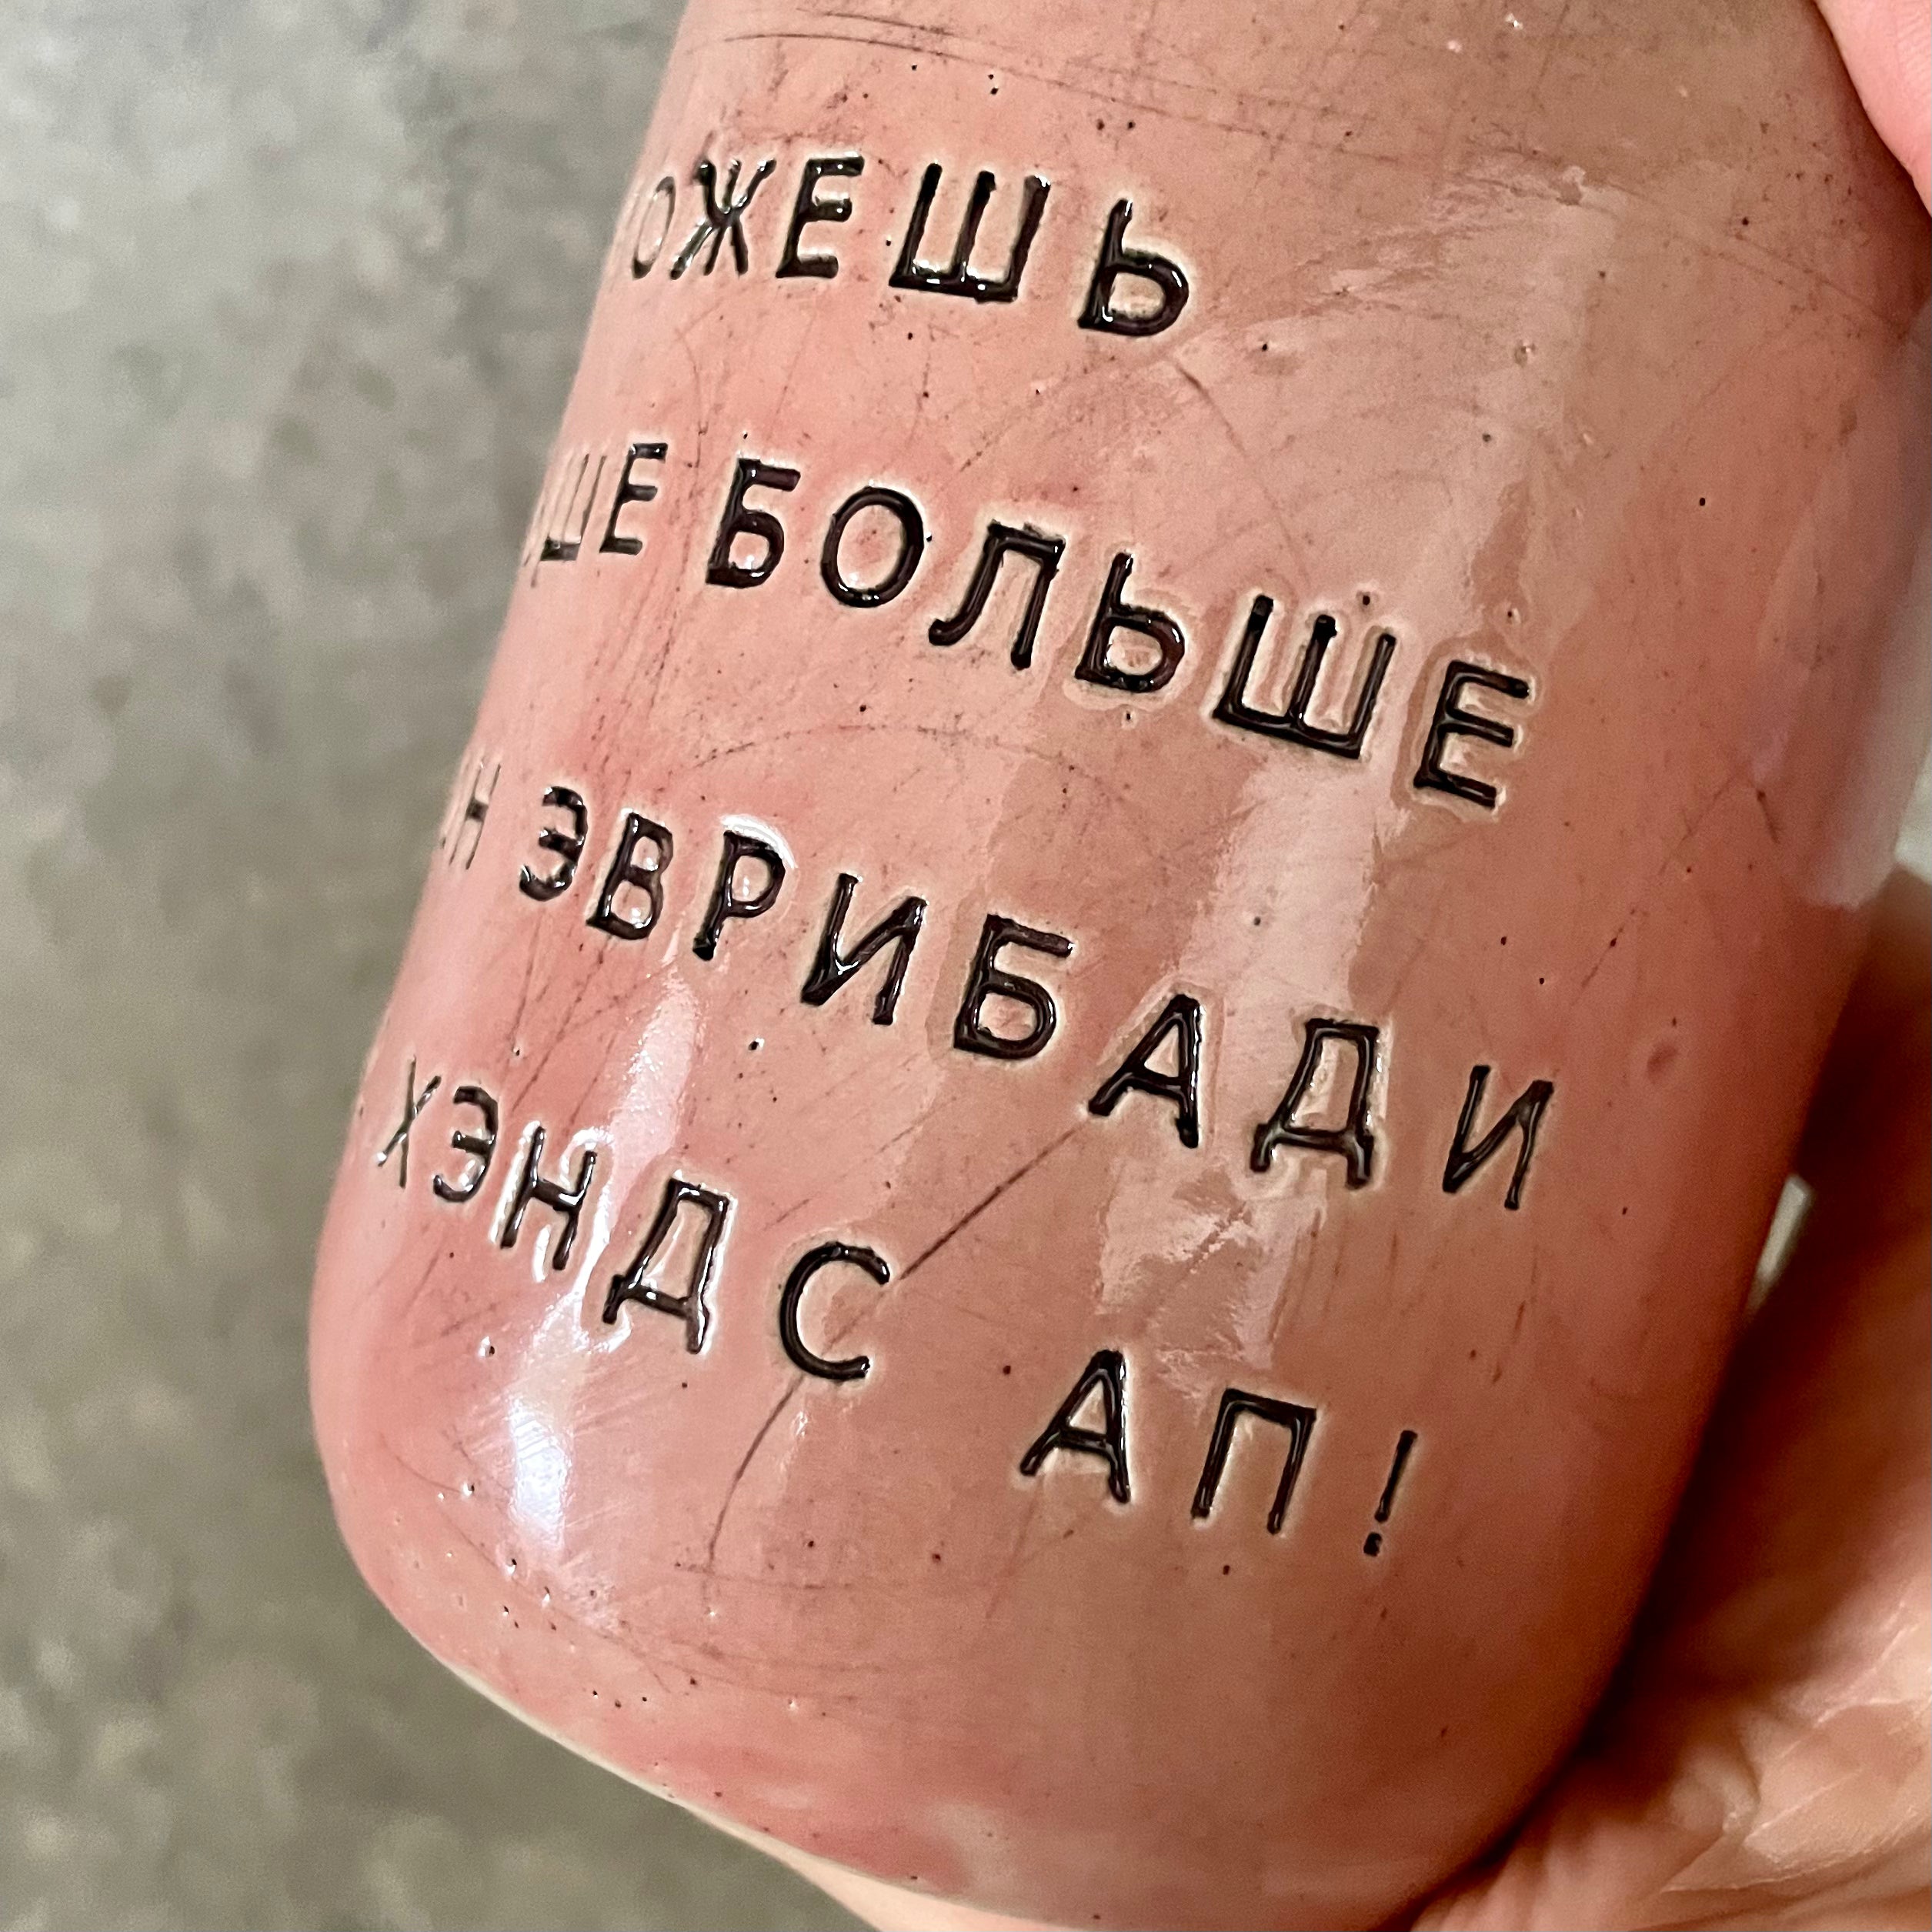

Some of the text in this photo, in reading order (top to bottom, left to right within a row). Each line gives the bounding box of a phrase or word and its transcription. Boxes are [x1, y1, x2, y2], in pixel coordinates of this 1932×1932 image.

[617, 155, 1190, 336] ОЖЕШЬ
[706, 457, 1530, 808] БОЛЬШЕ
[519, 785, 1553, 1211] ЭВРИБАДИ
[376, 1055, 1418, 1557] ХЭНДС АП!
